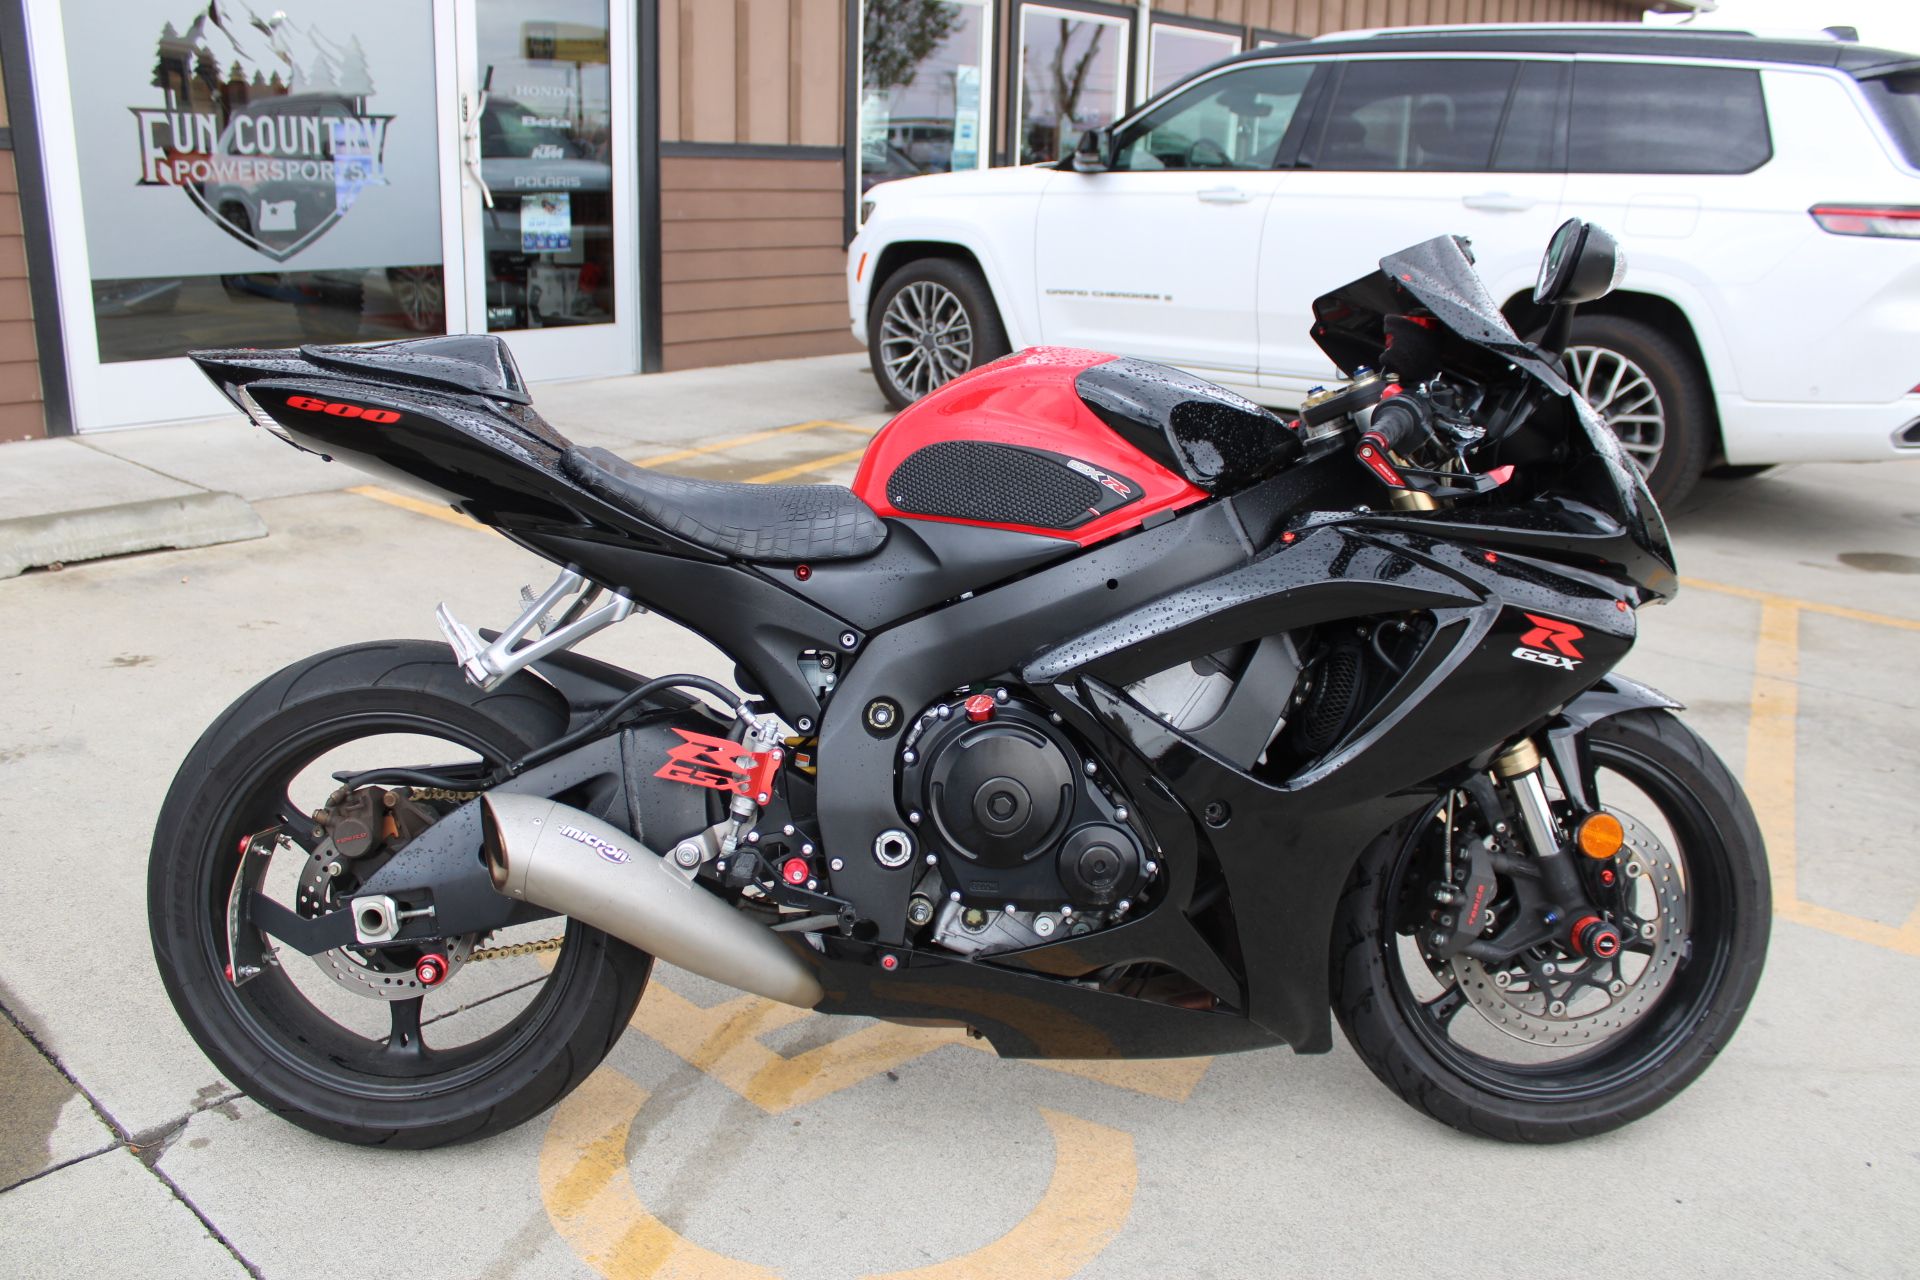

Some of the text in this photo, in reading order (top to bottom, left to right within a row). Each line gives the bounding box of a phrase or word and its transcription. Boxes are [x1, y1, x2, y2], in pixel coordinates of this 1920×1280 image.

[515, 85, 576, 98] HONDA
[521, 116, 572, 129] Beta
[138, 110, 388, 183] FUN COUNTRY
[531, 144, 565, 160] KTM
[174, 159, 367, 182] POWERSPORTS
[514, 176, 581, 189] POLARIS
[286, 395, 402, 425] 600
[1520, 611, 1585, 660] R
[1511, 646, 1583, 671] GSX
[560, 824, 631, 865] micron
